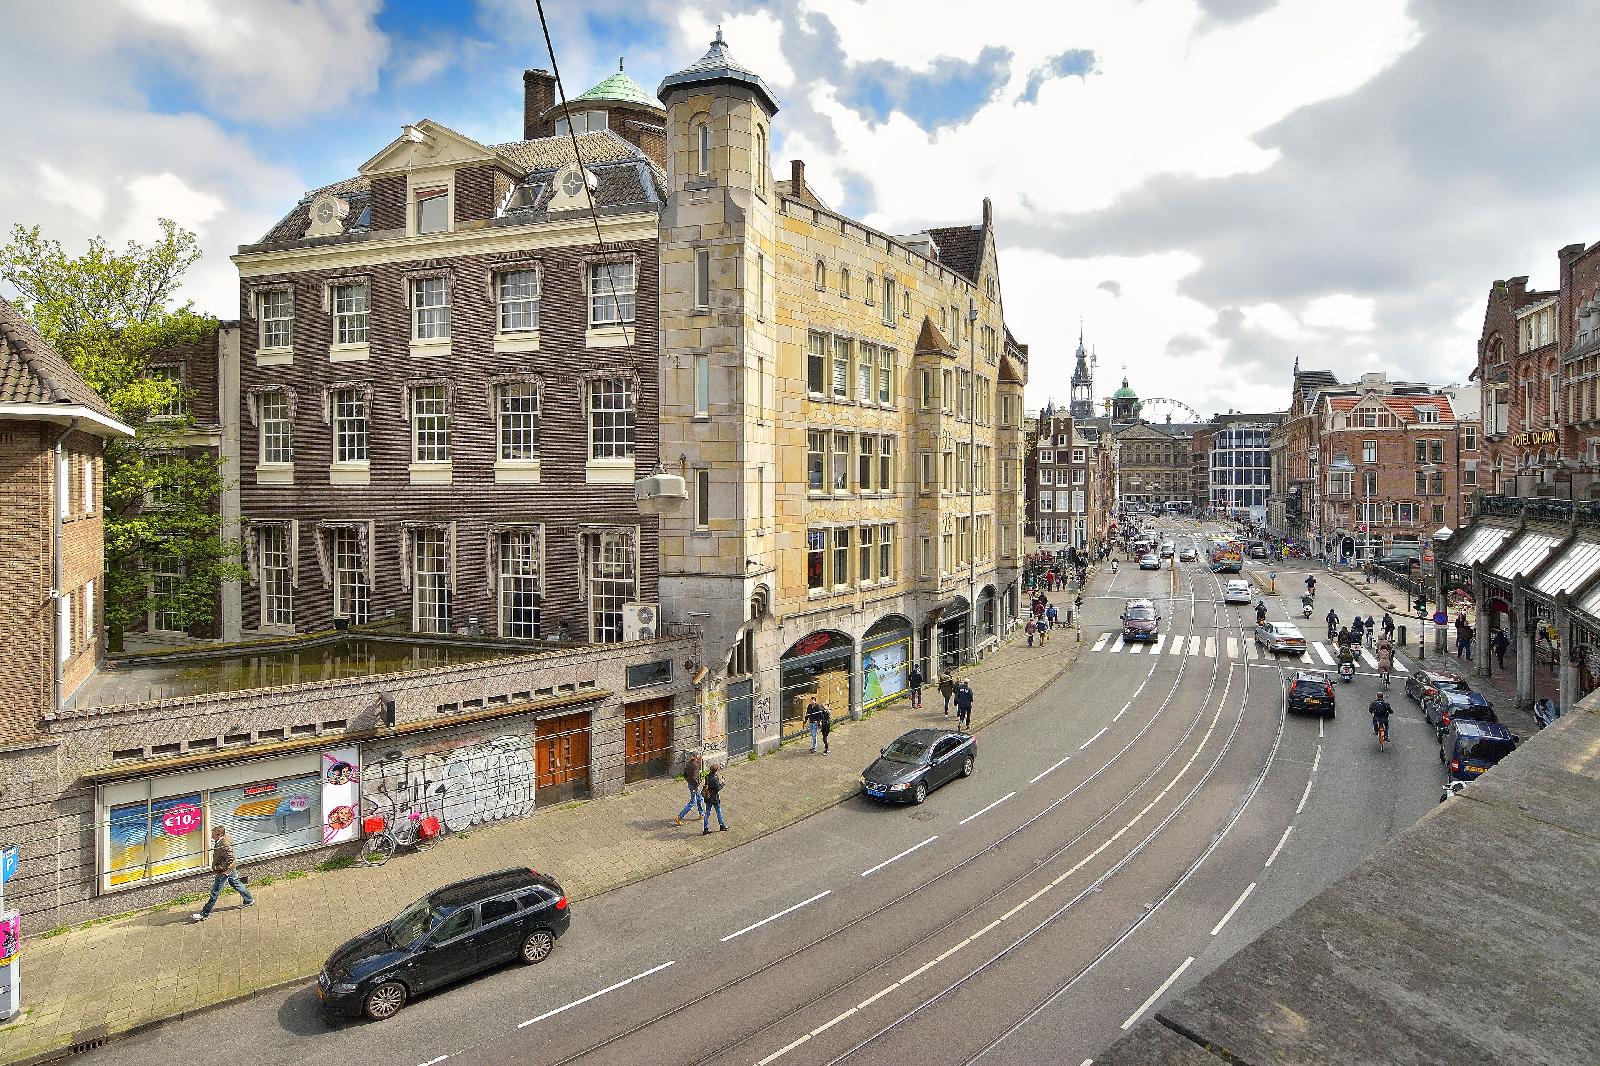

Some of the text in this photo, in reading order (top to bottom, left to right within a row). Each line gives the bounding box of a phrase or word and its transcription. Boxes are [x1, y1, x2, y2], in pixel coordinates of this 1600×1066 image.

[1511, 433, 1530, 446] HOTEL
[164, 814, 201, 827] €10,-
[6, 857, 14, 871] P
